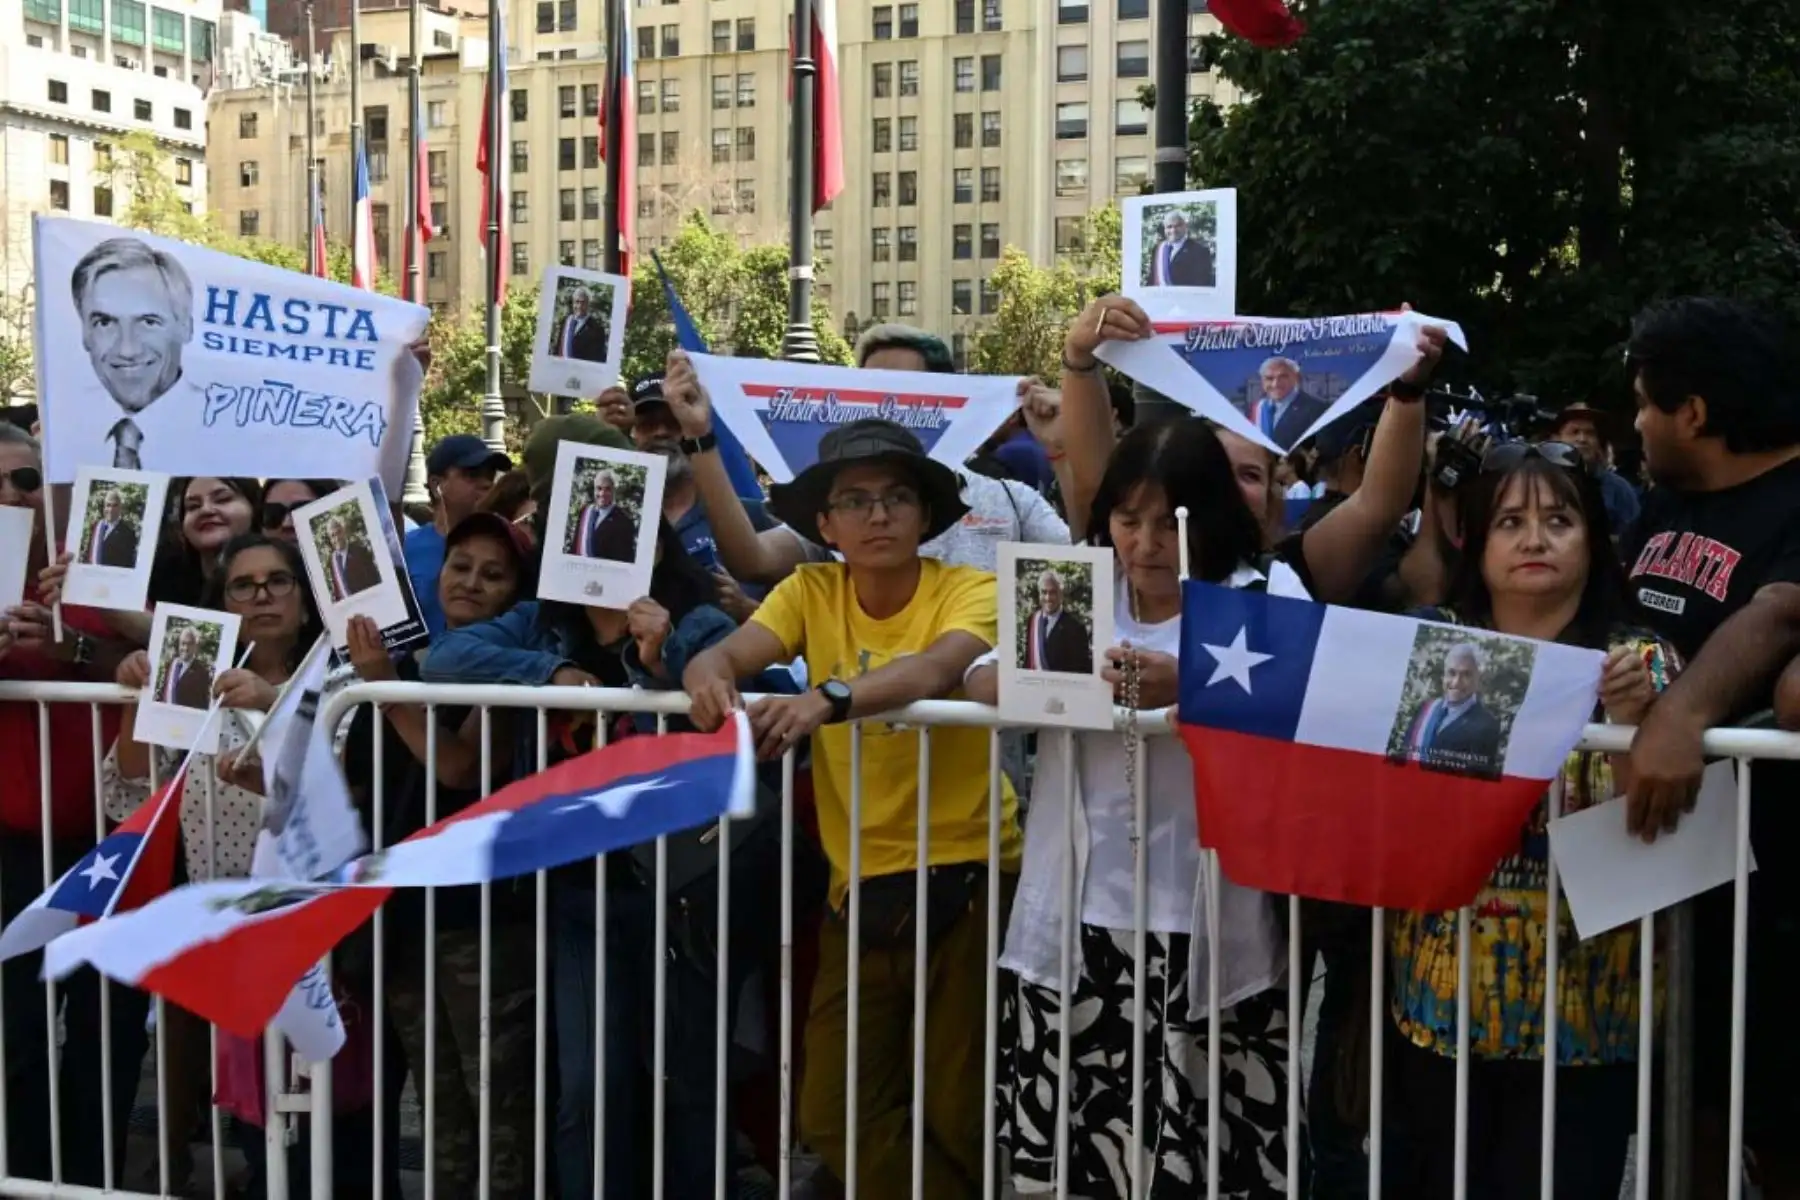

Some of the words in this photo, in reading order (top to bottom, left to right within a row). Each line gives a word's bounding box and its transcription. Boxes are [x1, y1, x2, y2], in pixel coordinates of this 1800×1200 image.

[203, 285, 379, 342] HASTA
[203, 331, 376, 371] SIEMPRE
[1184, 325, 1242, 352] Hasta
[1243, 321, 1308, 355] Siempre
[202, 379, 388, 448] PIÑERA
[767, 388, 818, 422] Hasta
